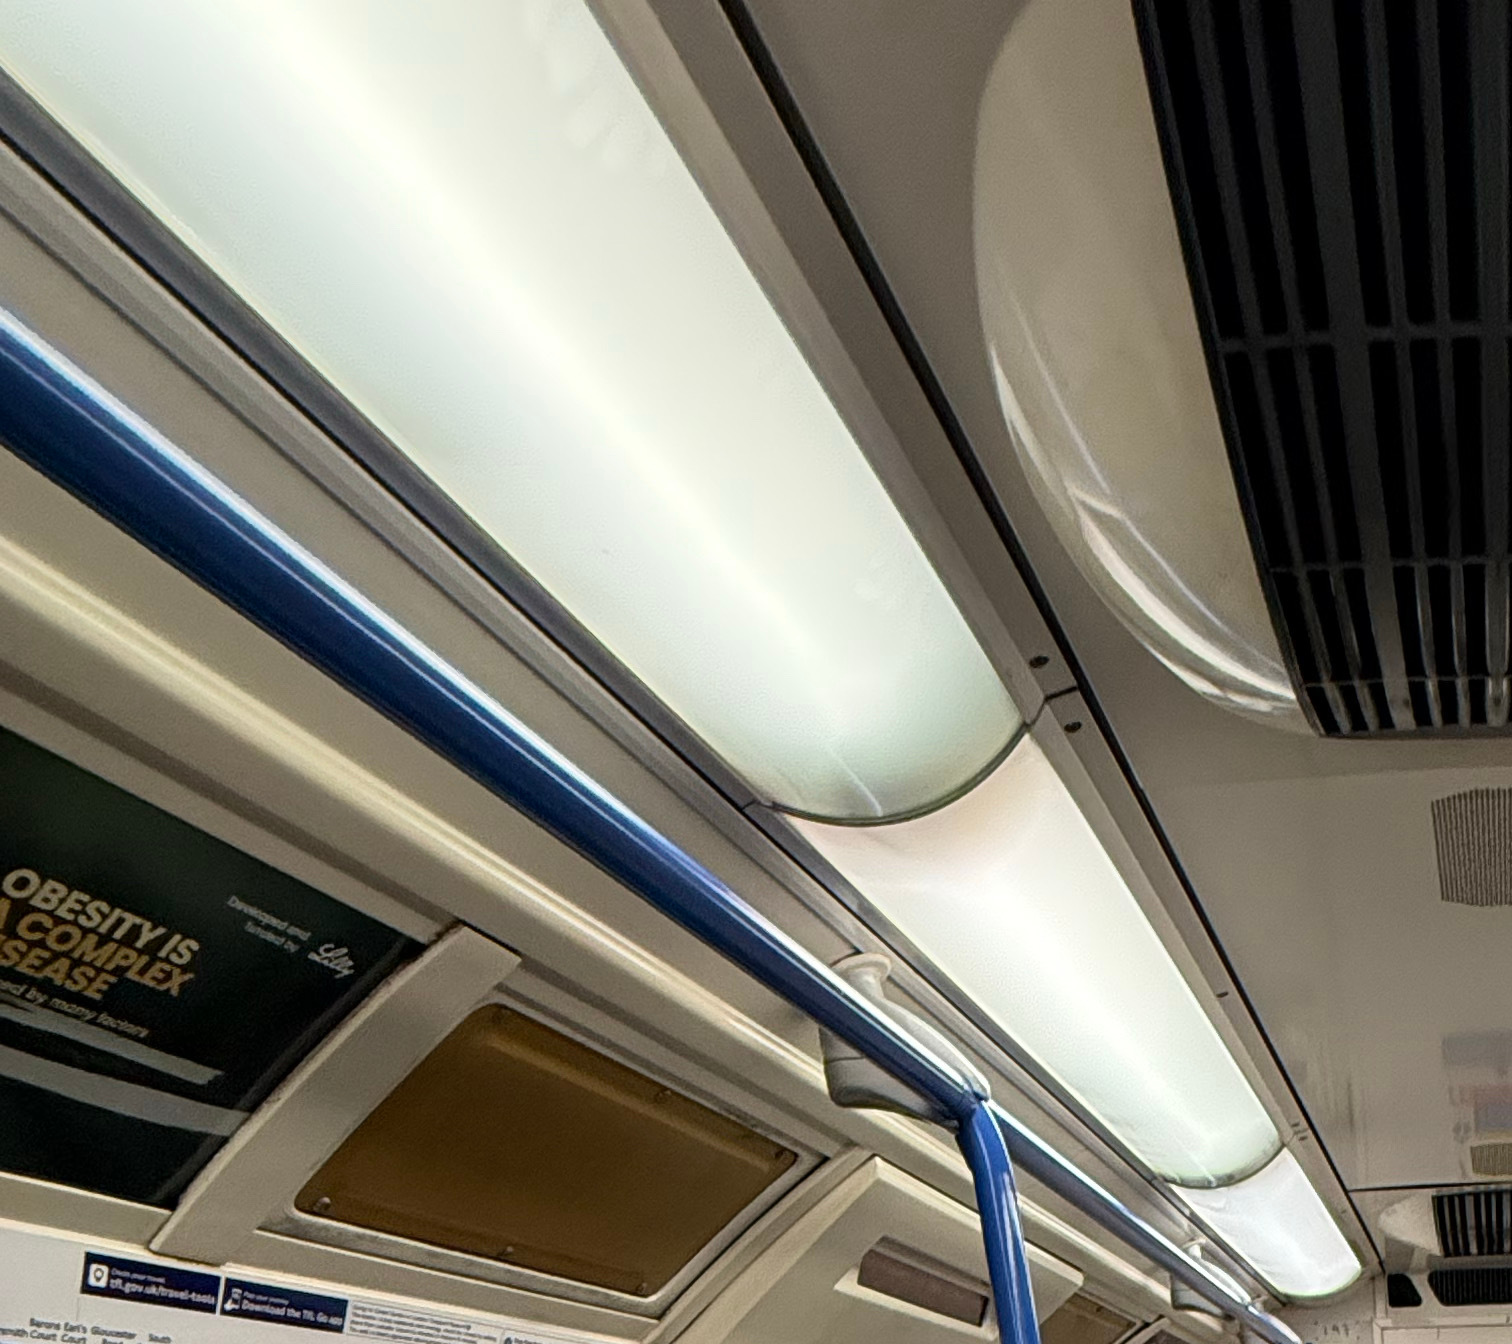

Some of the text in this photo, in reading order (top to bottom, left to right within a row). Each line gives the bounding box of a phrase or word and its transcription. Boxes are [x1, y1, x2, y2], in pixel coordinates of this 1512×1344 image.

[2, 868, 168, 949] OBESITY
[157, 934, 200, 965] IS
[0, 938, 119, 1000] SEASE
[16, 912, 194, 997] COMPLEX
[307, 943, 355, 979] Lilly
[241, 1299, 286, 1318] Download
[286, 1306, 301, 1319] the
[316, 1312, 328, 1324] Go
